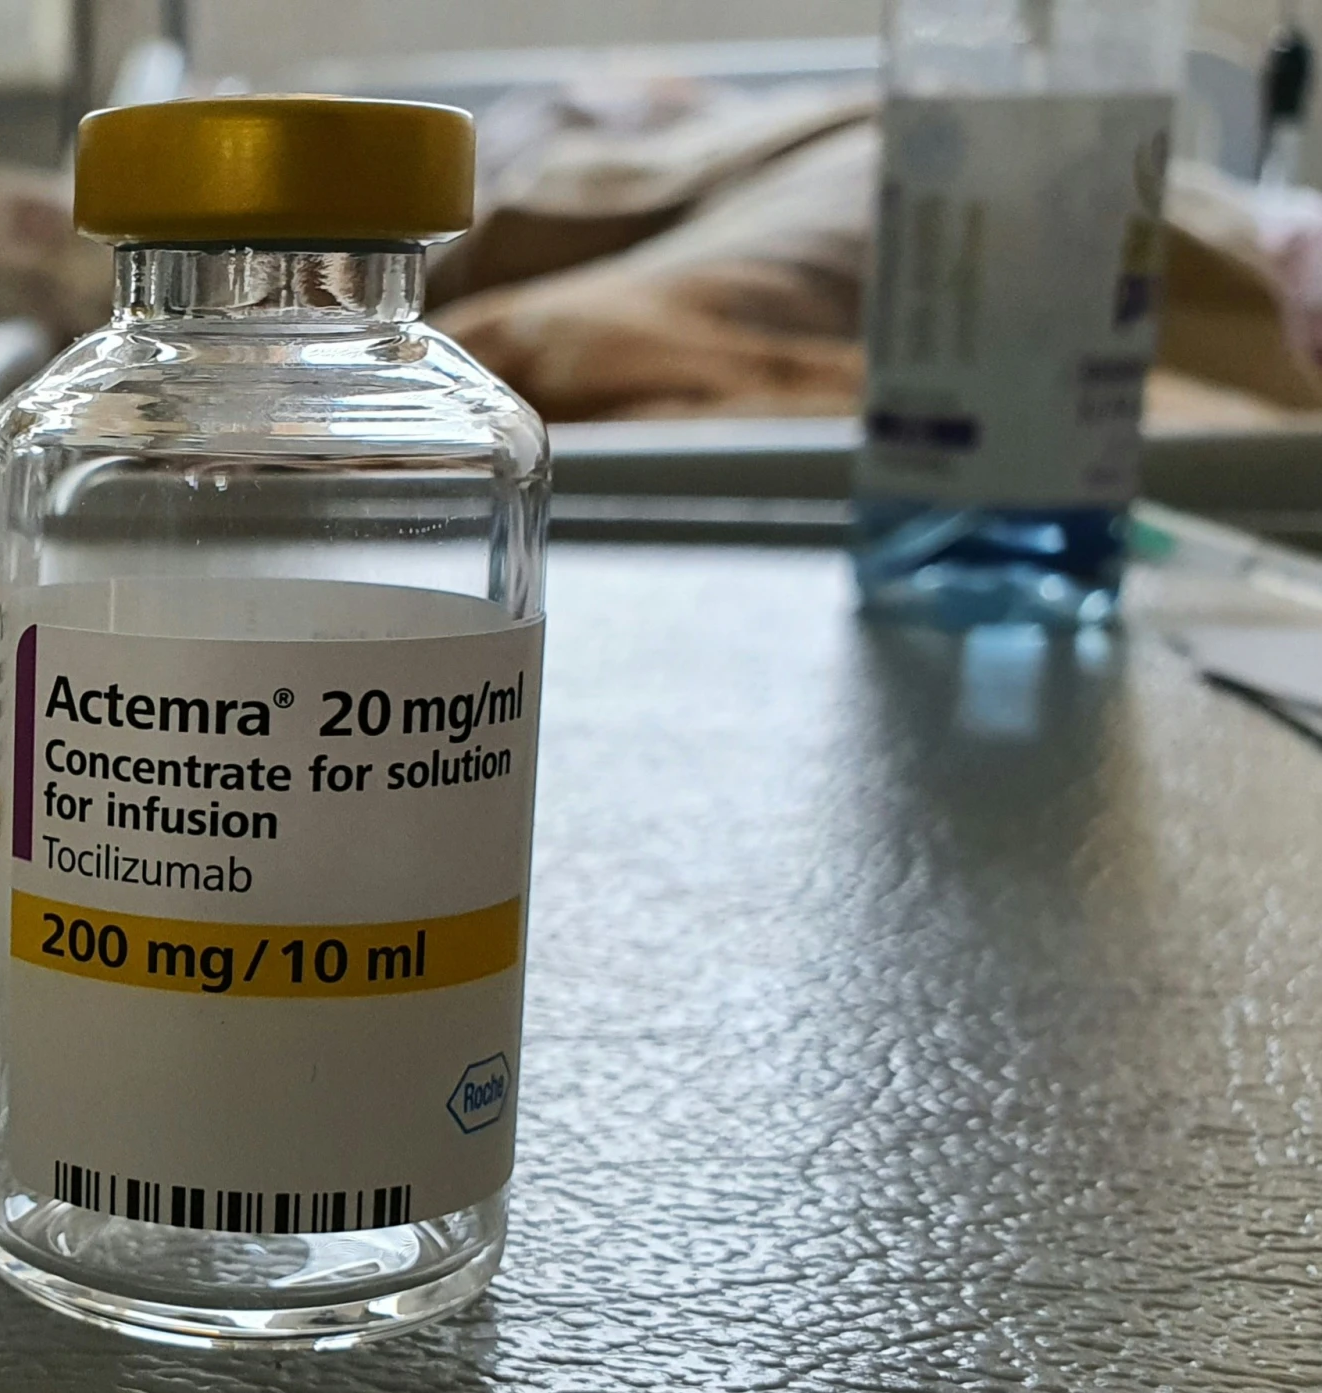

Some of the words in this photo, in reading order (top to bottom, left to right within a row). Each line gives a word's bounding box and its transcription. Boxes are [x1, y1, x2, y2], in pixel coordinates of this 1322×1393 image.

[318, 688, 391, 737] 20
[401, 671, 524, 743] mg/ml
[44, 738, 292, 792] Concentrate
[308, 754, 372, 792] for
[387, 745, 512, 790] solution
[44, 782, 93, 822] for
[106, 792, 278, 839] infusion
[42, 834, 253, 893] Tocilizumab
[41, 912, 128, 968] 200
[367, 930, 427, 981] ml
[463, 1073, 505, 1114] Roche
